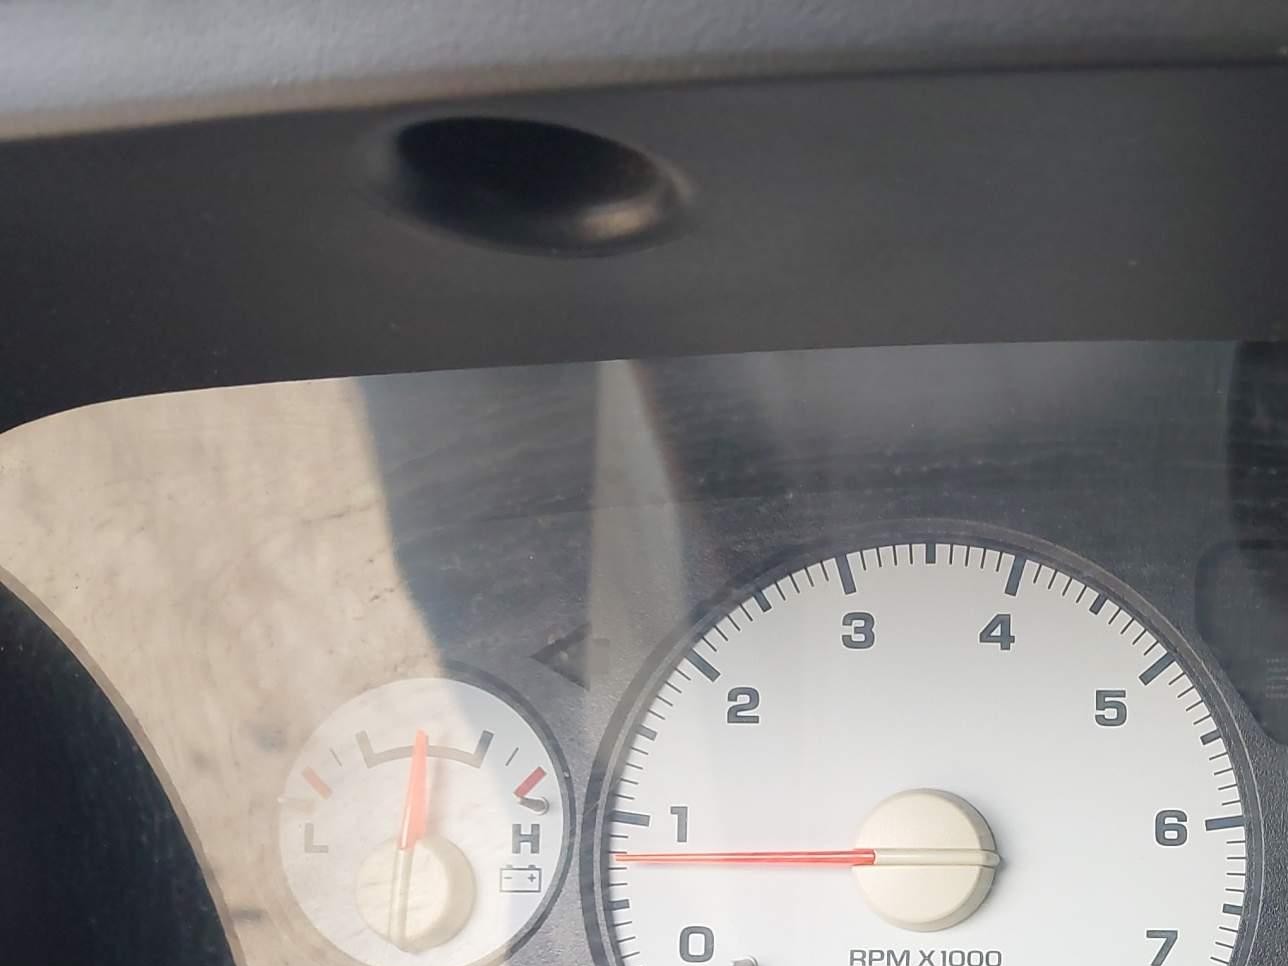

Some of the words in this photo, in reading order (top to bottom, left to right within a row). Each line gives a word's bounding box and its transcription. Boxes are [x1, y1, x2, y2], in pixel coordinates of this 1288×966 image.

[841, 611, 875, 650] 3
[979, 614, 1015, 651] 4
[726, 687, 761, 724] 2
[1094, 689, 1127, 727] 5
[304, 822, 330, 854] L
[510, 822, 541, 855] H
[670, 805, 689, 844] 1
[1154, 809, 1188, 846] 6
[679, 925, 714, 964] 0
[1146, 929, 1178, 966] 7
